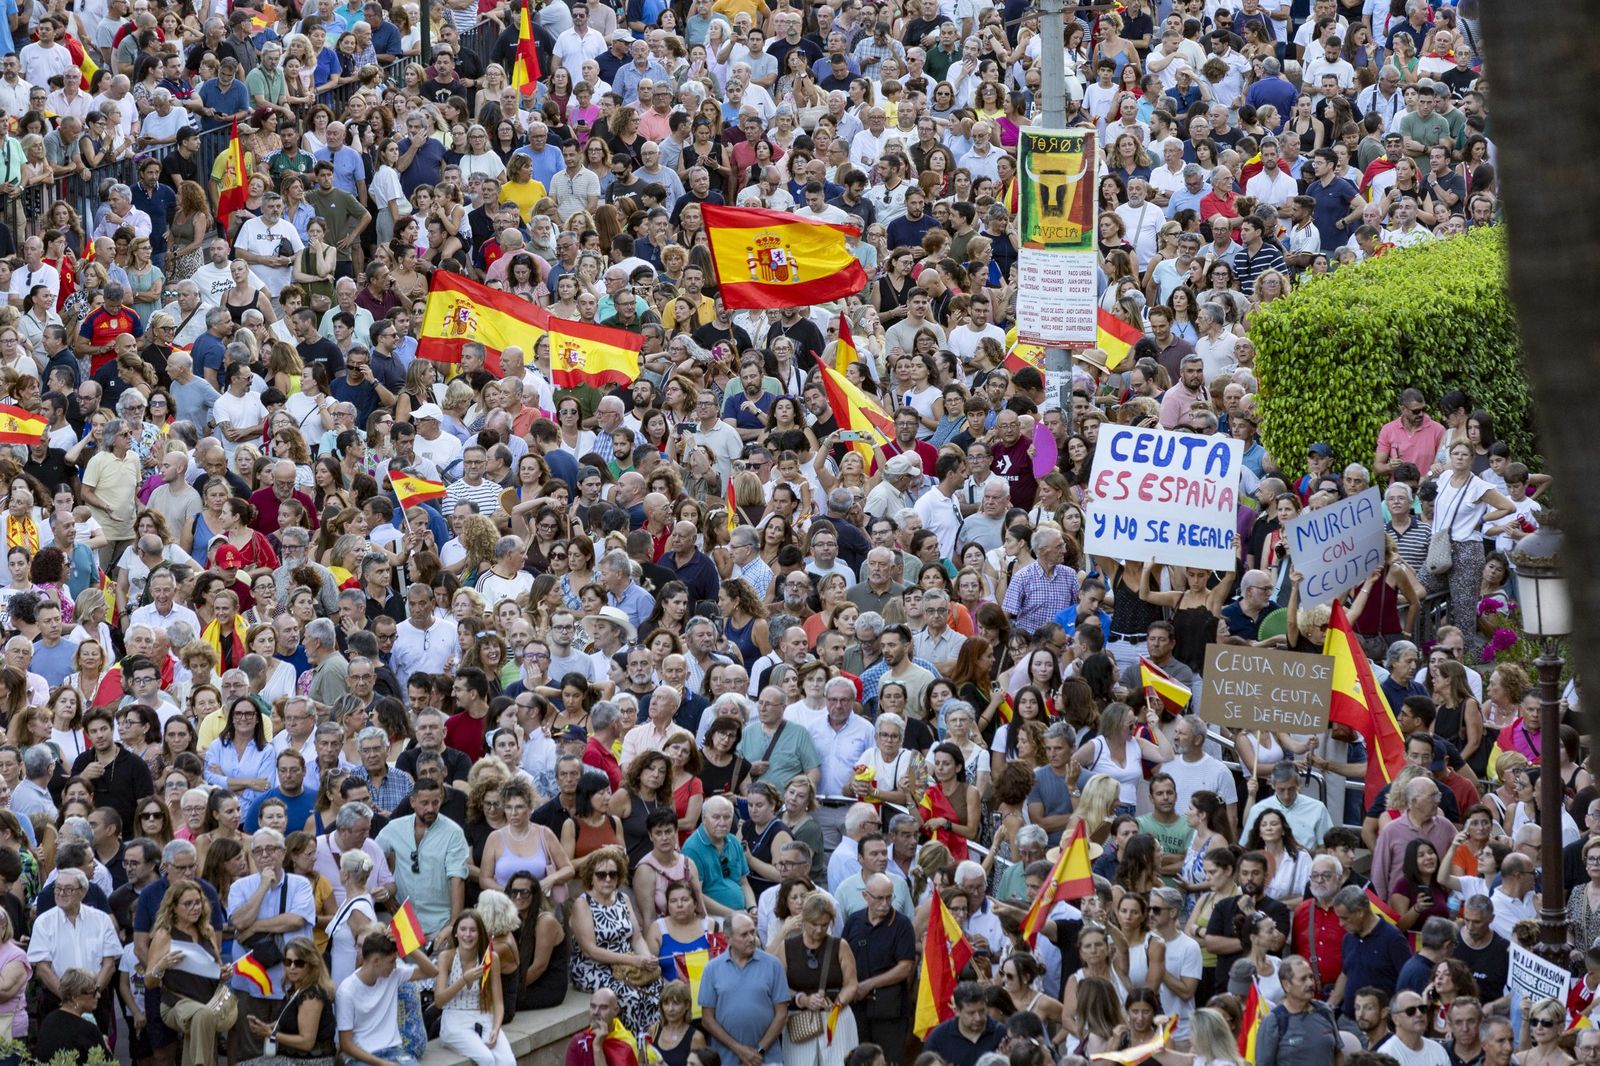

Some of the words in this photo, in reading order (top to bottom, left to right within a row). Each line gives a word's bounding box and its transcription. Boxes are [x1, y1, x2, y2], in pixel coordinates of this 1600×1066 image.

[1033, 225, 1078, 239] MURCIA
[66, 272, 72, 284] 9
[212, 278, 233, 288] Studio
[1111, 431, 1231, 478] CEUTA
[1094, 470, 1132, 500] ES
[1138, 473, 1233, 512] ESPAÑA
[1093, 513, 1106, 538] Y
[1114, 514, 1138, 541] NO
[1144, 520, 1170, 543] SE
[1177, 523, 1234, 549] REGALA
[1296, 498, 1374, 552] MURCIA
[1322, 537, 1355, 563] CON
[1306, 548, 1380, 598] CEUTA
[1215, 651, 1274, 675] CEUTA
[1283, 662, 1305, 678] NO
[1309, 664, 1331, 680] SE
[1212, 679, 1263, 696] VENDE
[1271, 687, 1324, 706] CEUTA
[1224, 701, 1242, 719] SE
[1253, 705, 1321, 727] DEFIENDE
[1513, 950, 1520, 962] NO
[1520, 955, 1524, 965] A
[1526, 958, 1533, 970] LA
[1534, 962, 1565, 986] INVASIÓN
[1537, 980, 1558, 997] CEUTA
